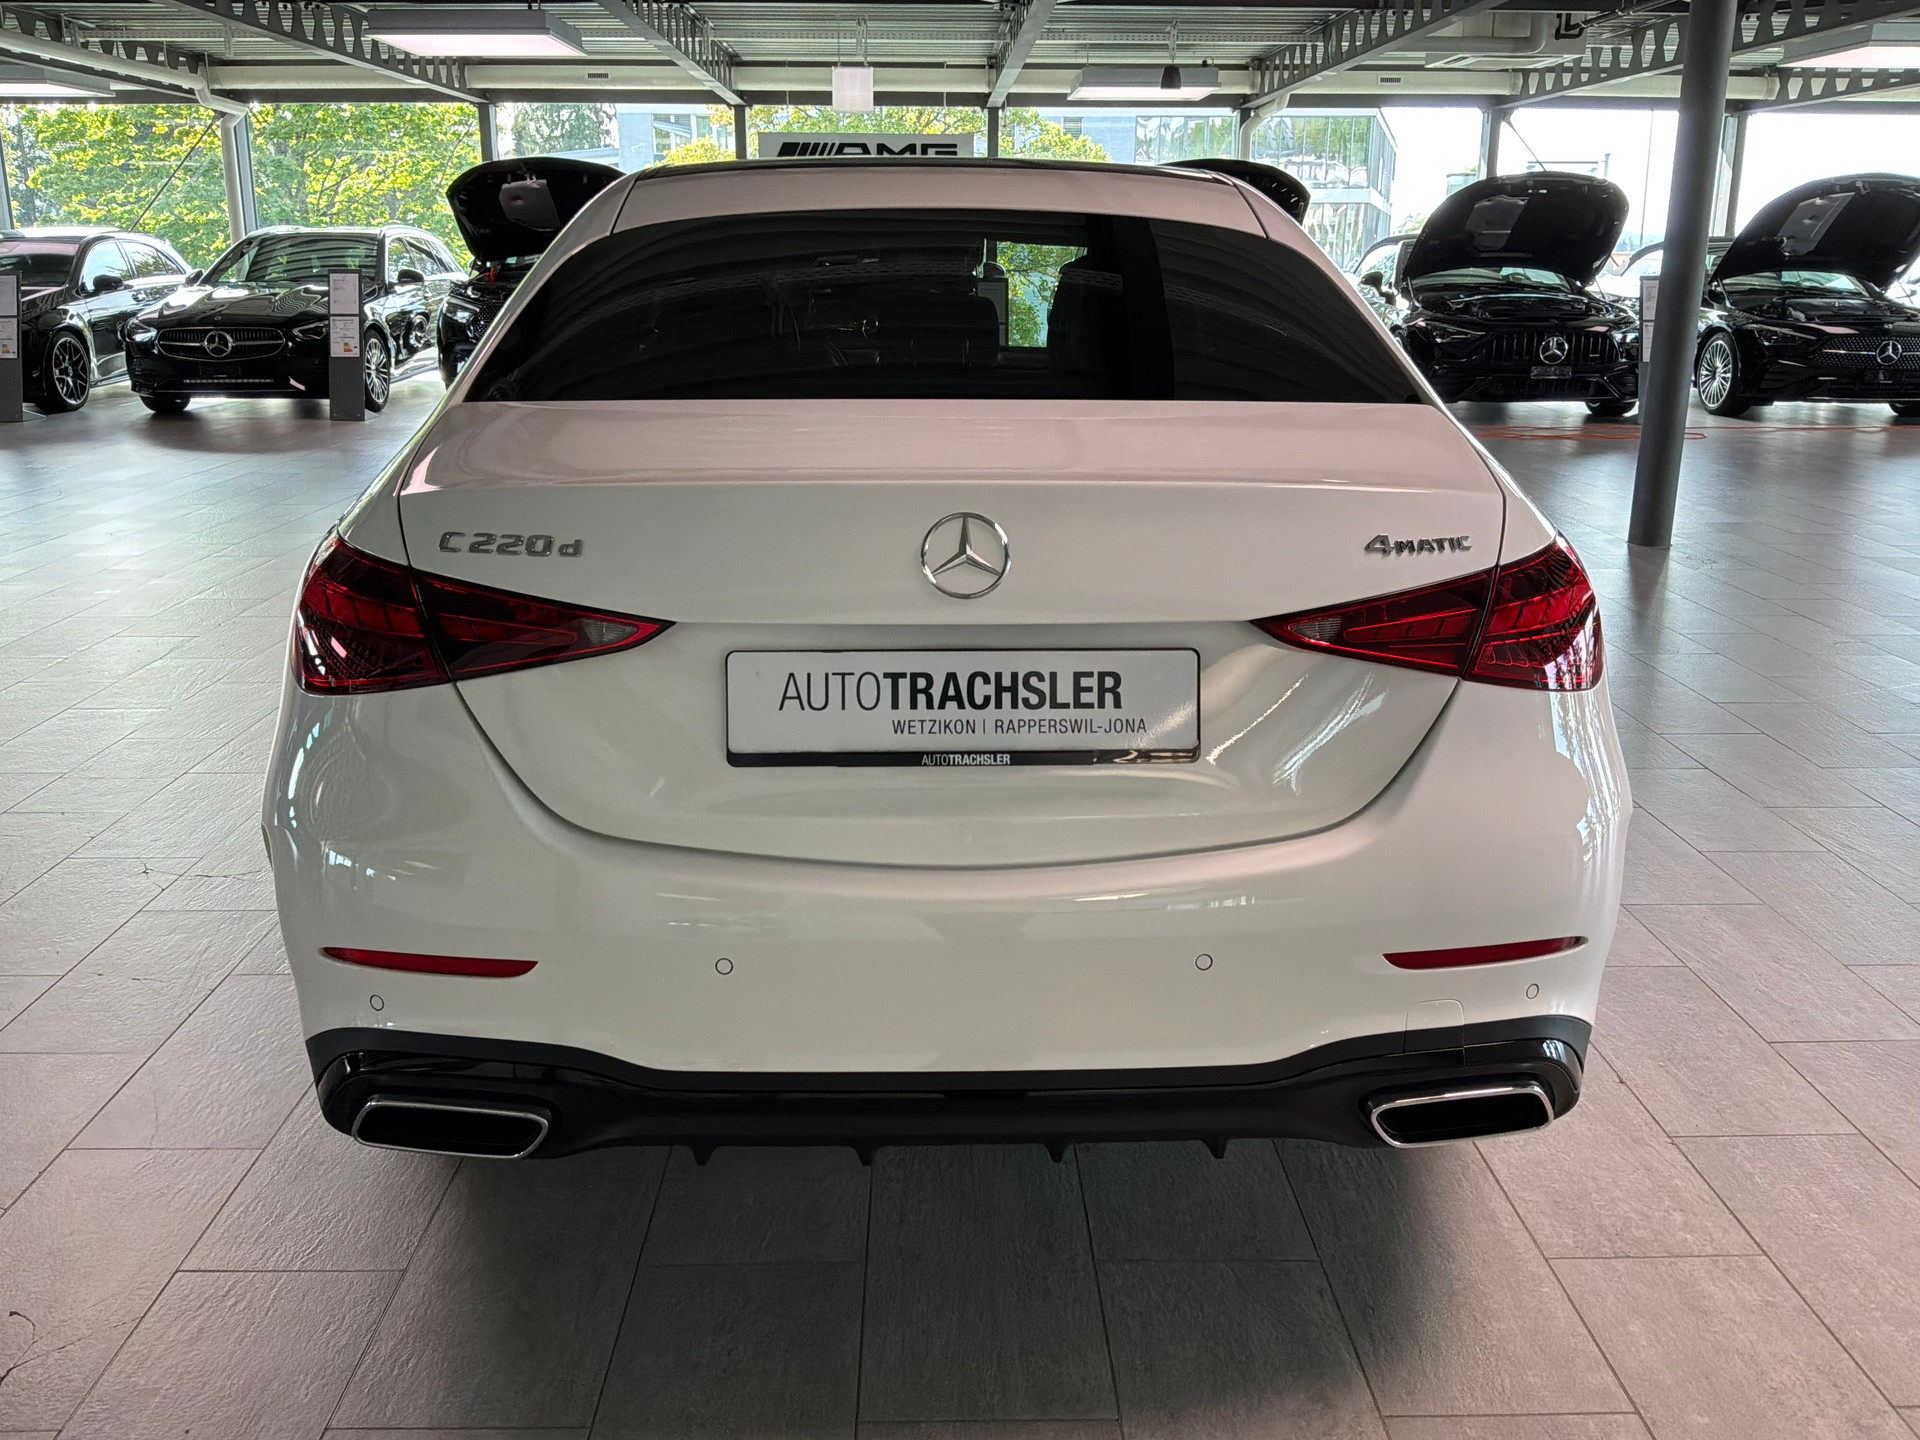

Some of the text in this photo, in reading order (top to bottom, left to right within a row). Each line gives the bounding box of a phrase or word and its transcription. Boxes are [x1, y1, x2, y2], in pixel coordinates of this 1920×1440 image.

[834, 142, 958, 157] AMG
[1364, 533, 1473, 557] 4MATIC
[778, 671, 1123, 711] AUTOTRACHSLER
[891, 719, 976, 735] WETZIKON
[994, 717, 1148, 734] RAPPERSWIL-JONA
[921, 753, 1011, 766] AUTOTRACHSLER
